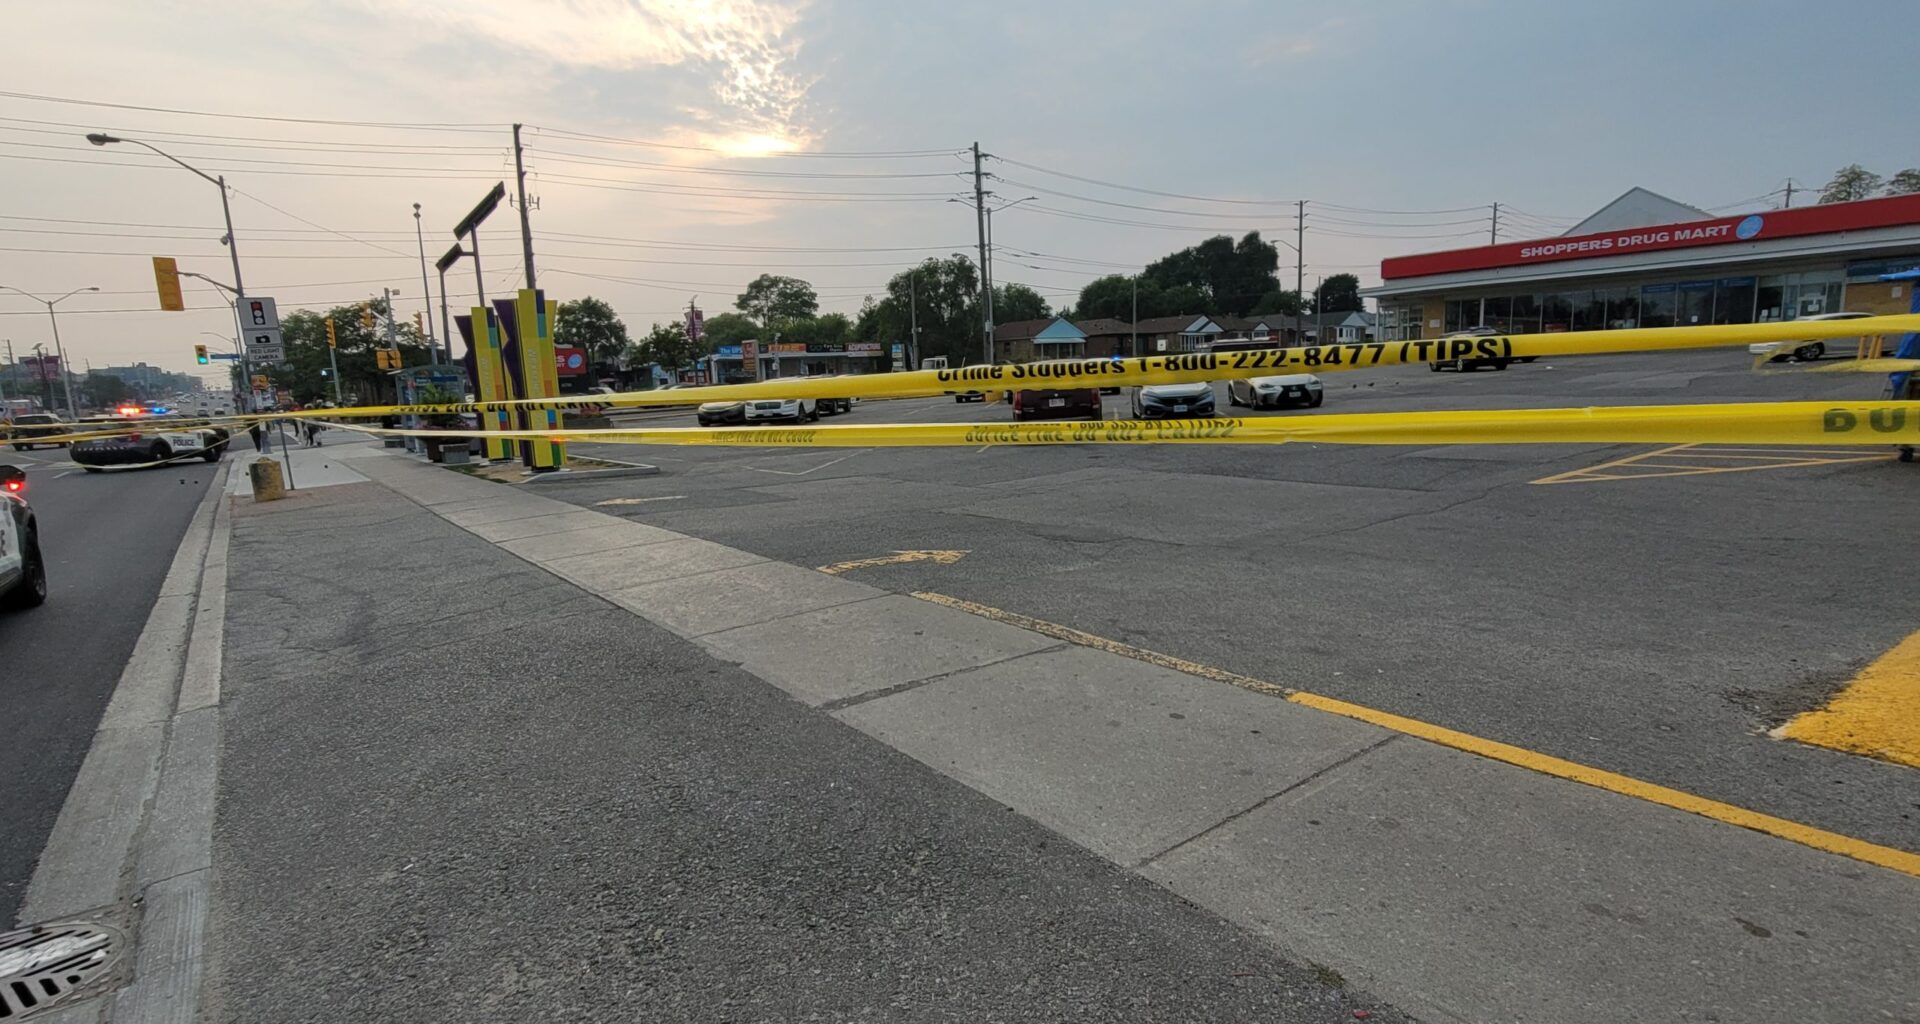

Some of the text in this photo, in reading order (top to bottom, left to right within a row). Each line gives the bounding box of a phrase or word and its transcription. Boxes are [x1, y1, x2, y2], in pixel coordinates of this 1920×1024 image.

[1520, 224, 1732, 258] SHOPPERS DRUG MART
[1399, 337, 1512, 363] (TIPS)
[173, 438, 195, 446] POLICE
